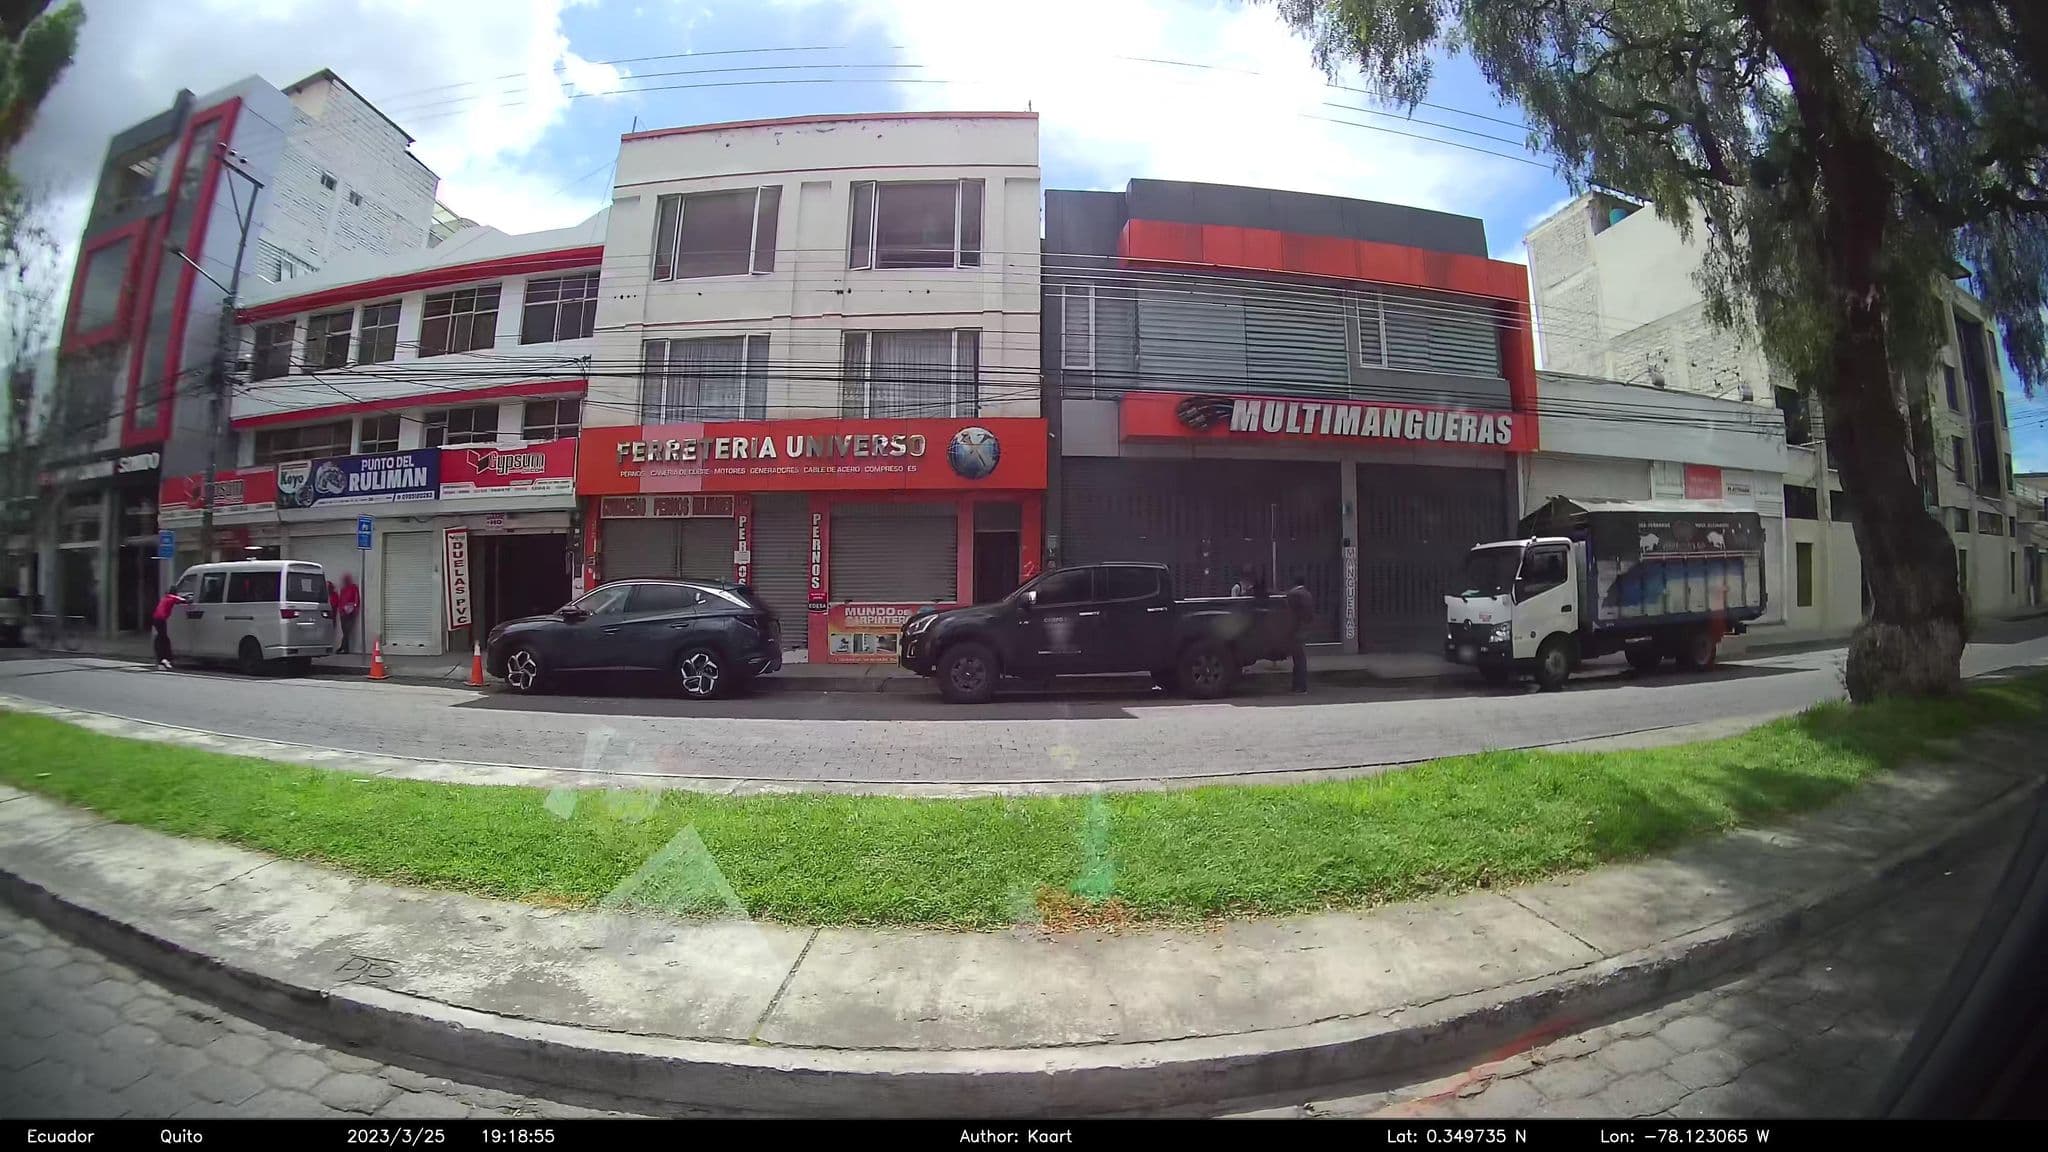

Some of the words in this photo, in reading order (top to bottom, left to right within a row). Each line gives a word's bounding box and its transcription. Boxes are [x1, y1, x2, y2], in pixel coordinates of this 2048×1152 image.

[1230, 399, 1514, 445] MULTIMANGUERAS
[786, 434, 927, 458] UNIVERSO
[361, 457, 395, 471] PUNTO
[396, 455, 414, 468] DEL
[488, 450, 546, 475] Gypsum
[750, 467, 800, 475] GENERADORES
[803, 466, 826, 474] CABLE
[281, 471, 304, 489] Koyo
[811, 513, 821, 589] PERNOS
[452, 541, 465, 595] DUELAS
[456, 598, 467, 624] PVC
[845, 607, 896, 616] MUNDO
[845, 615, 909, 625] CARPINTER
